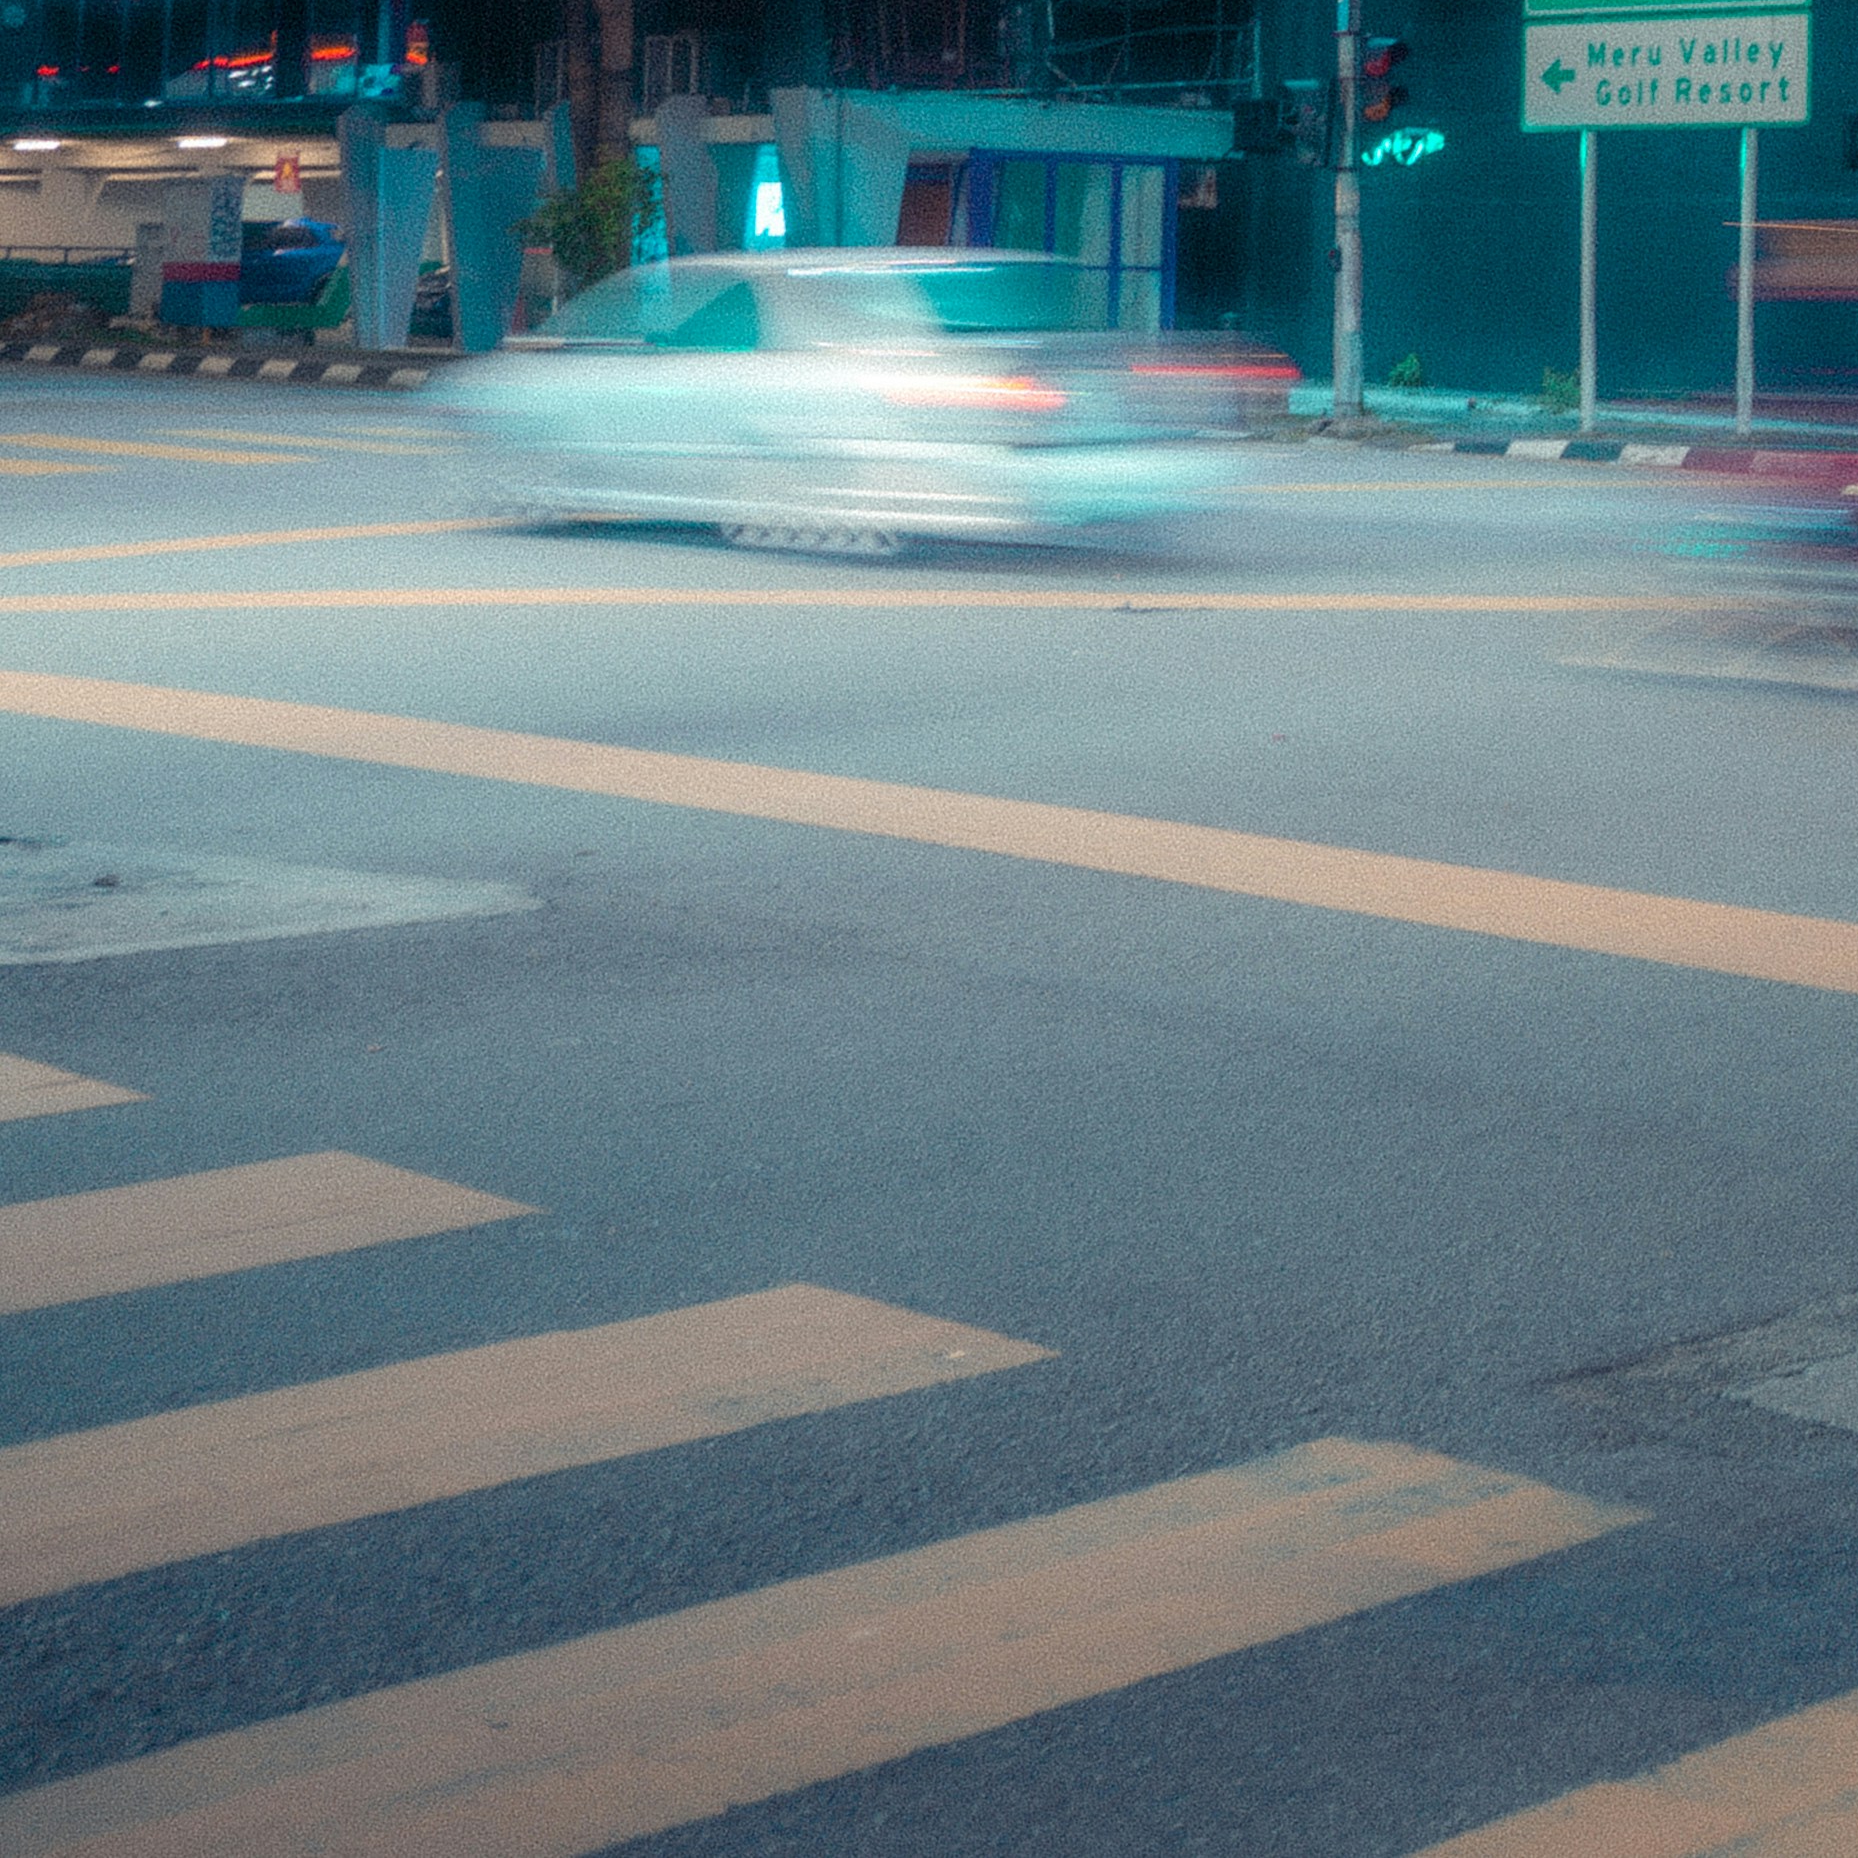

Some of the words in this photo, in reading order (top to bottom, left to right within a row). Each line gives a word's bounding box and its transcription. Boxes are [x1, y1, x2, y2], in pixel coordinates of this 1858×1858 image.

[1587, 40, 1662, 68] Meru
[1679, 37, 1784, 70] Valley
[1595, 78, 1659, 107] Golf
[1675, 76, 1790, 105] Resort
